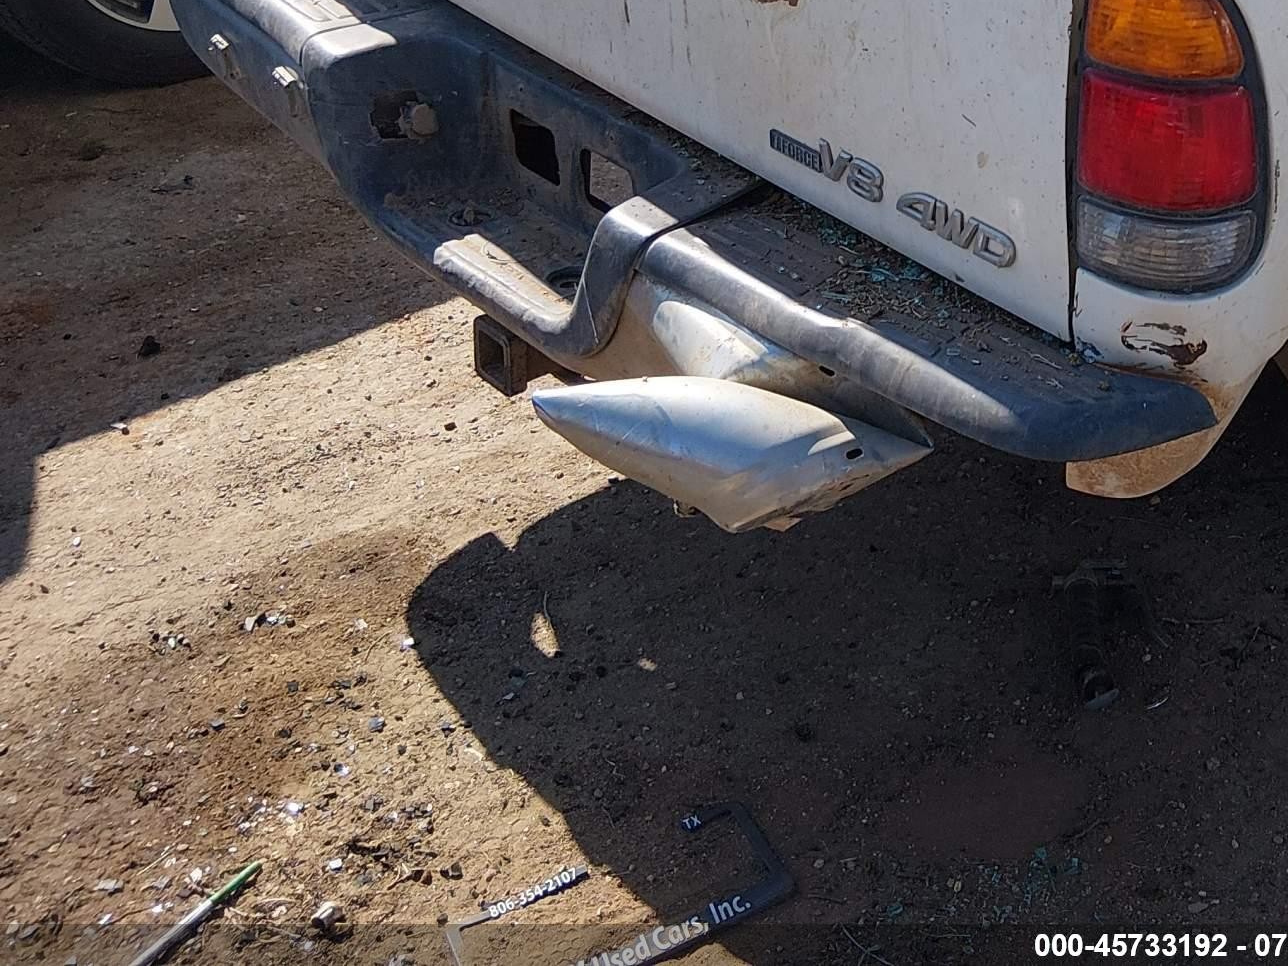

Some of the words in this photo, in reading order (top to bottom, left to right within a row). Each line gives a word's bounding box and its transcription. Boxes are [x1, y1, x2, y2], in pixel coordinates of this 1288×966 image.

[818, 137, 885, 203] V8
[896, 191, 1017, 268] 4WD
[683, 814, 702, 830] TX
[489, 867, 577, 918] 806-354-2107
[652, 915, 709, 950] Cars,
[709, 894, 751, 924] Inc.
